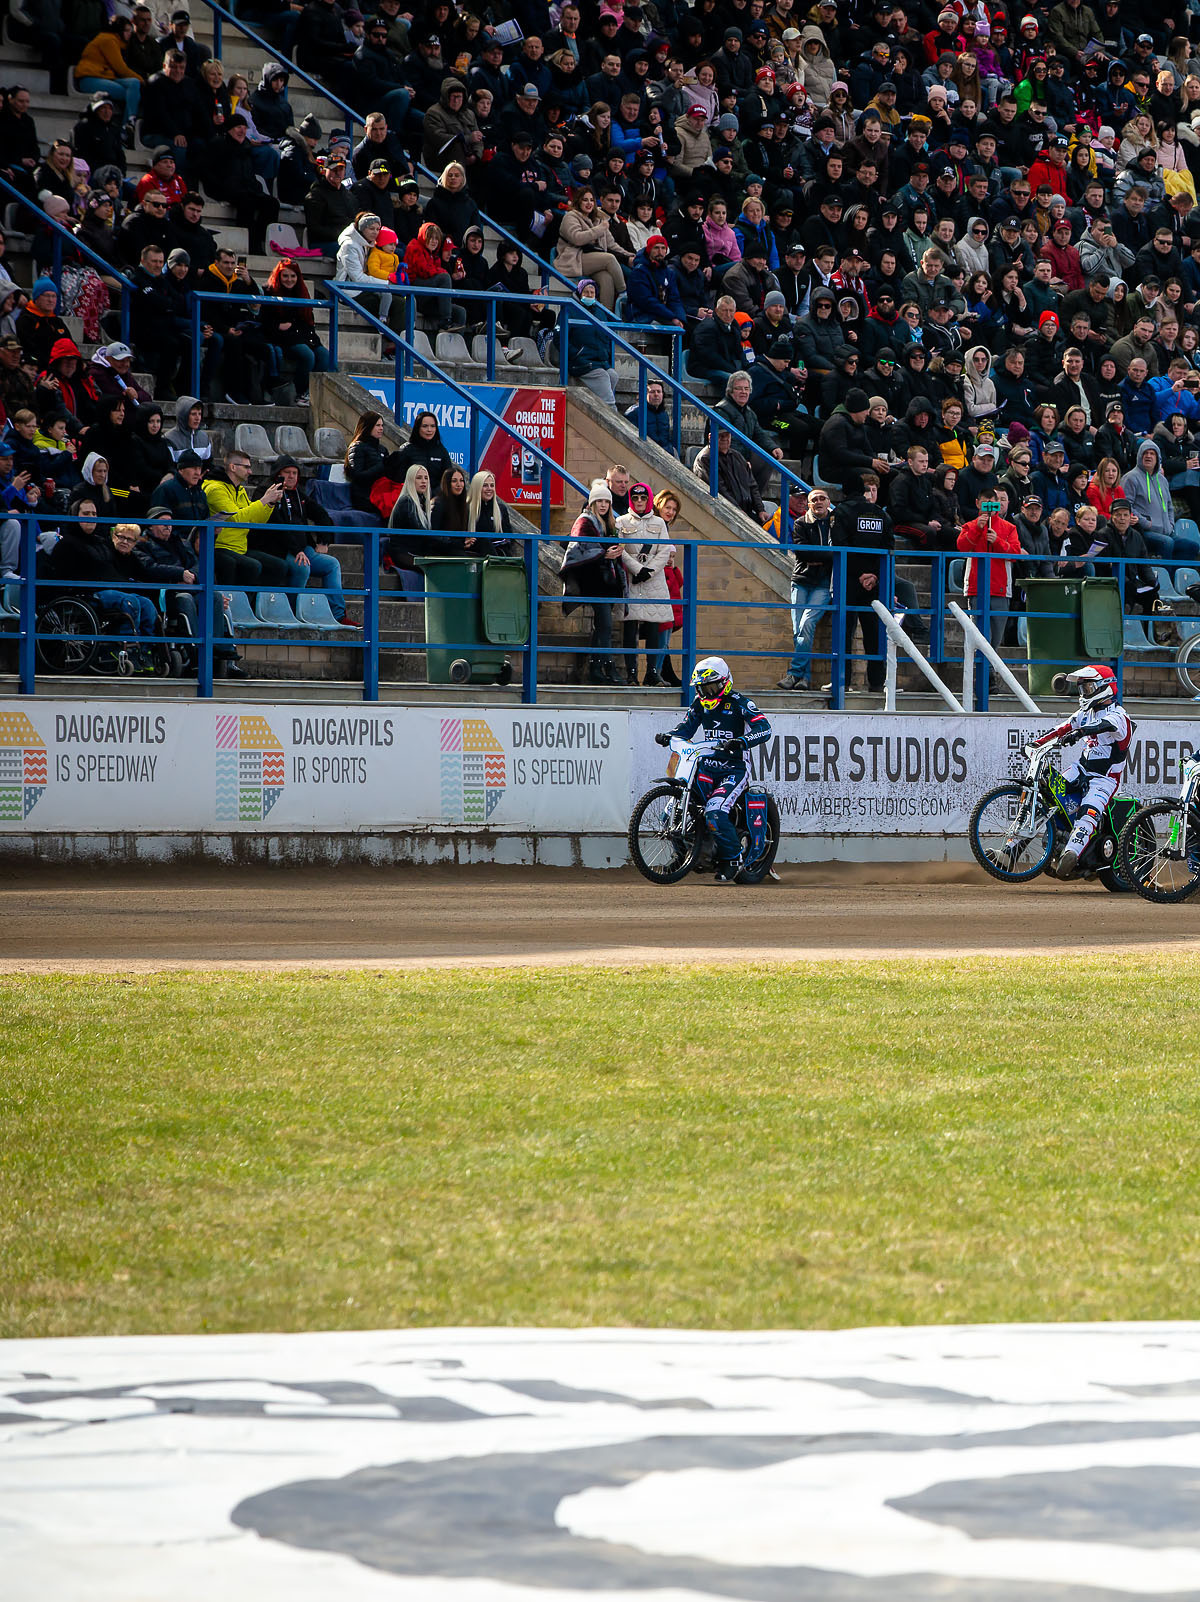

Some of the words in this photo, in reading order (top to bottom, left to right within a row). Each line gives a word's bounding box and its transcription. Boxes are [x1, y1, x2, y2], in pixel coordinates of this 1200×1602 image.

[393, 402, 471, 428] TOKKE
[541, 398, 555, 411] THE
[516, 411, 555, 425] ORIGINAL
[541, 427, 555, 438] OIL
[448, 452, 464, 464] PILS
[523, 491, 542, 500] Valvol
[860, 520, 882, 530] GROM
[55, 714, 166, 744] DAUGAVPILS
[291, 718, 394, 747] DAUGAVPILS
[512, 721, 610, 750] DAUGAVPILS
[55, 757, 70, 783] IS
[76, 757, 158, 783] SPEEDWAY
[292, 757, 307, 784] IR
[312, 756, 367, 785] SPORTS
[513, 760, 526, 786] IS
[531, 760, 603, 786] SPEEDWAY
[849, 736, 967, 784] STUDIOS
[777, 797, 950, 817] WW.AMBER-STUDIOS.COM
